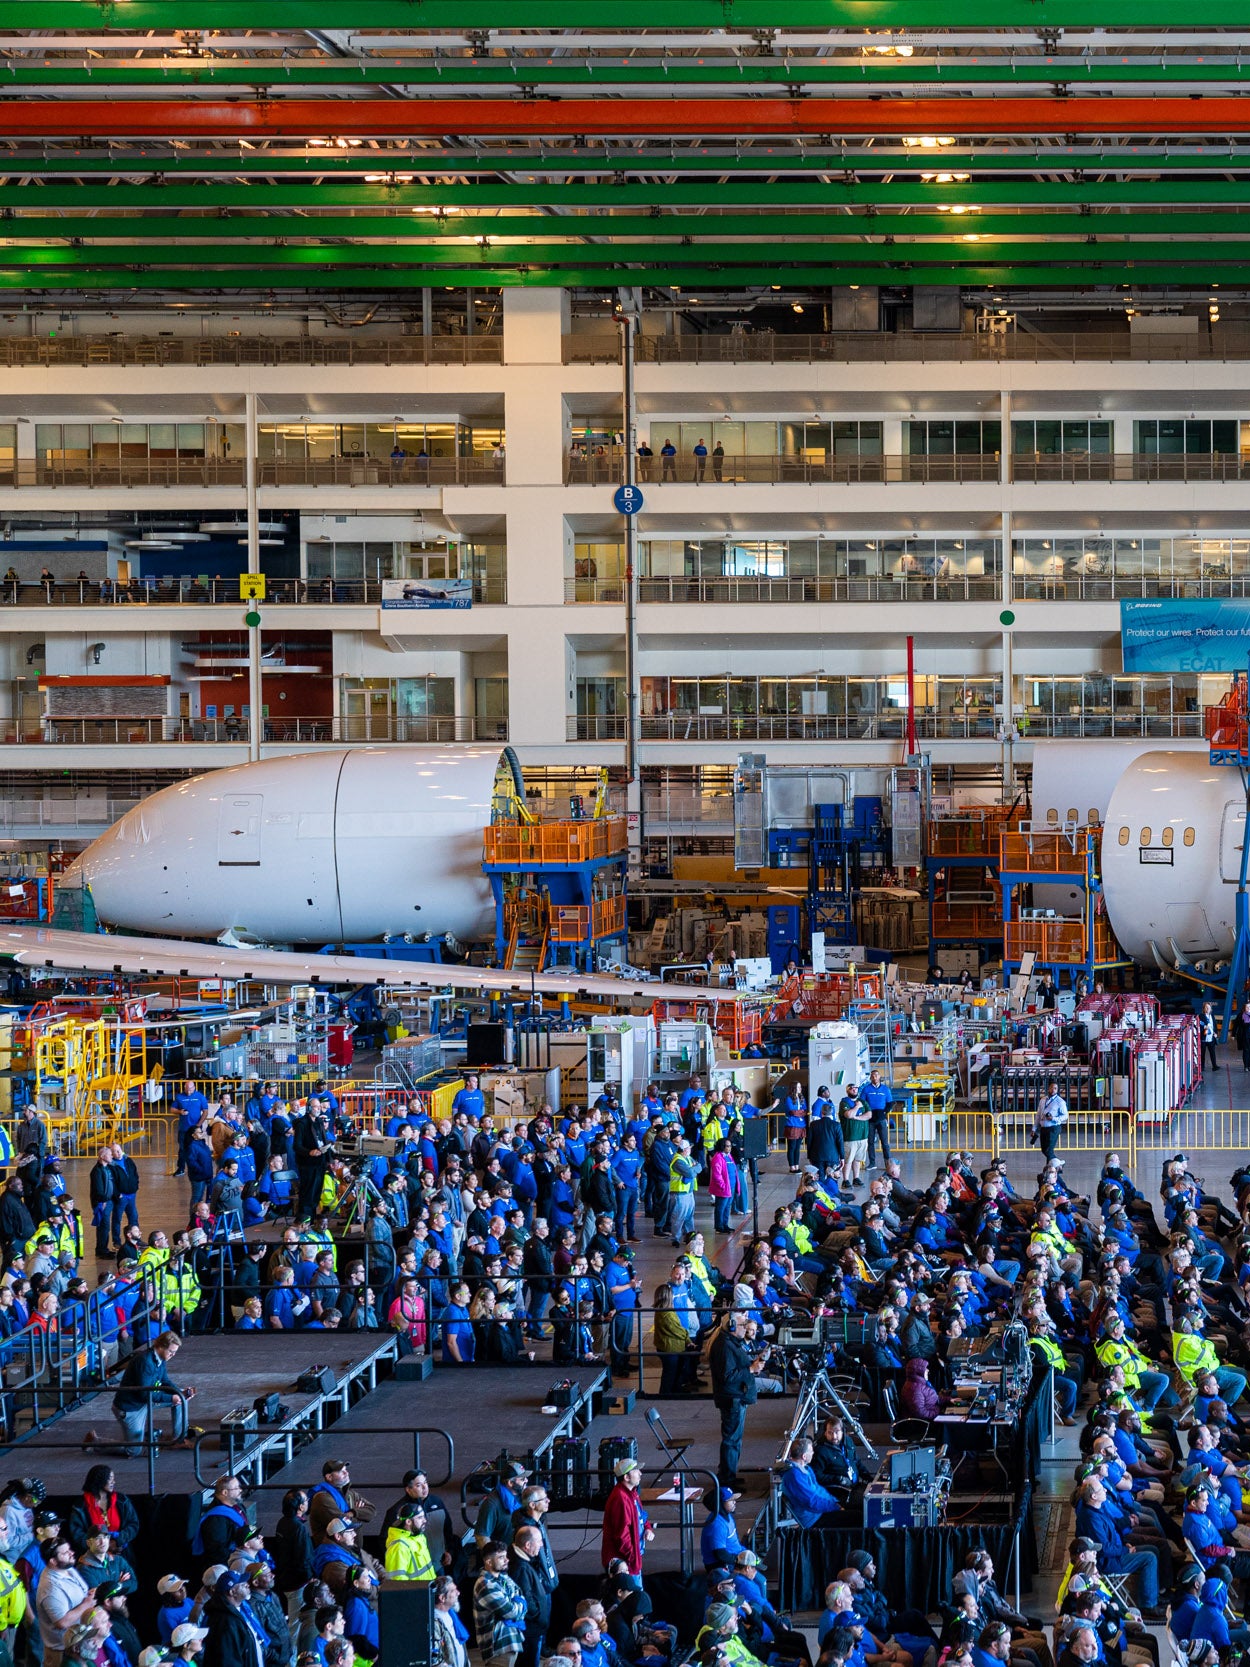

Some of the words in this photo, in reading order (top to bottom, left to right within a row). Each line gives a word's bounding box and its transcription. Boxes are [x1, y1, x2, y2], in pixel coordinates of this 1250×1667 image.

[624, 488, 633, 498] B
[624, 501, 633, 512] 3
[1127, 628, 1154, 636] Protect
[1196, 628, 1223, 636] Protect
[1180, 657, 1225, 672] ECAT
